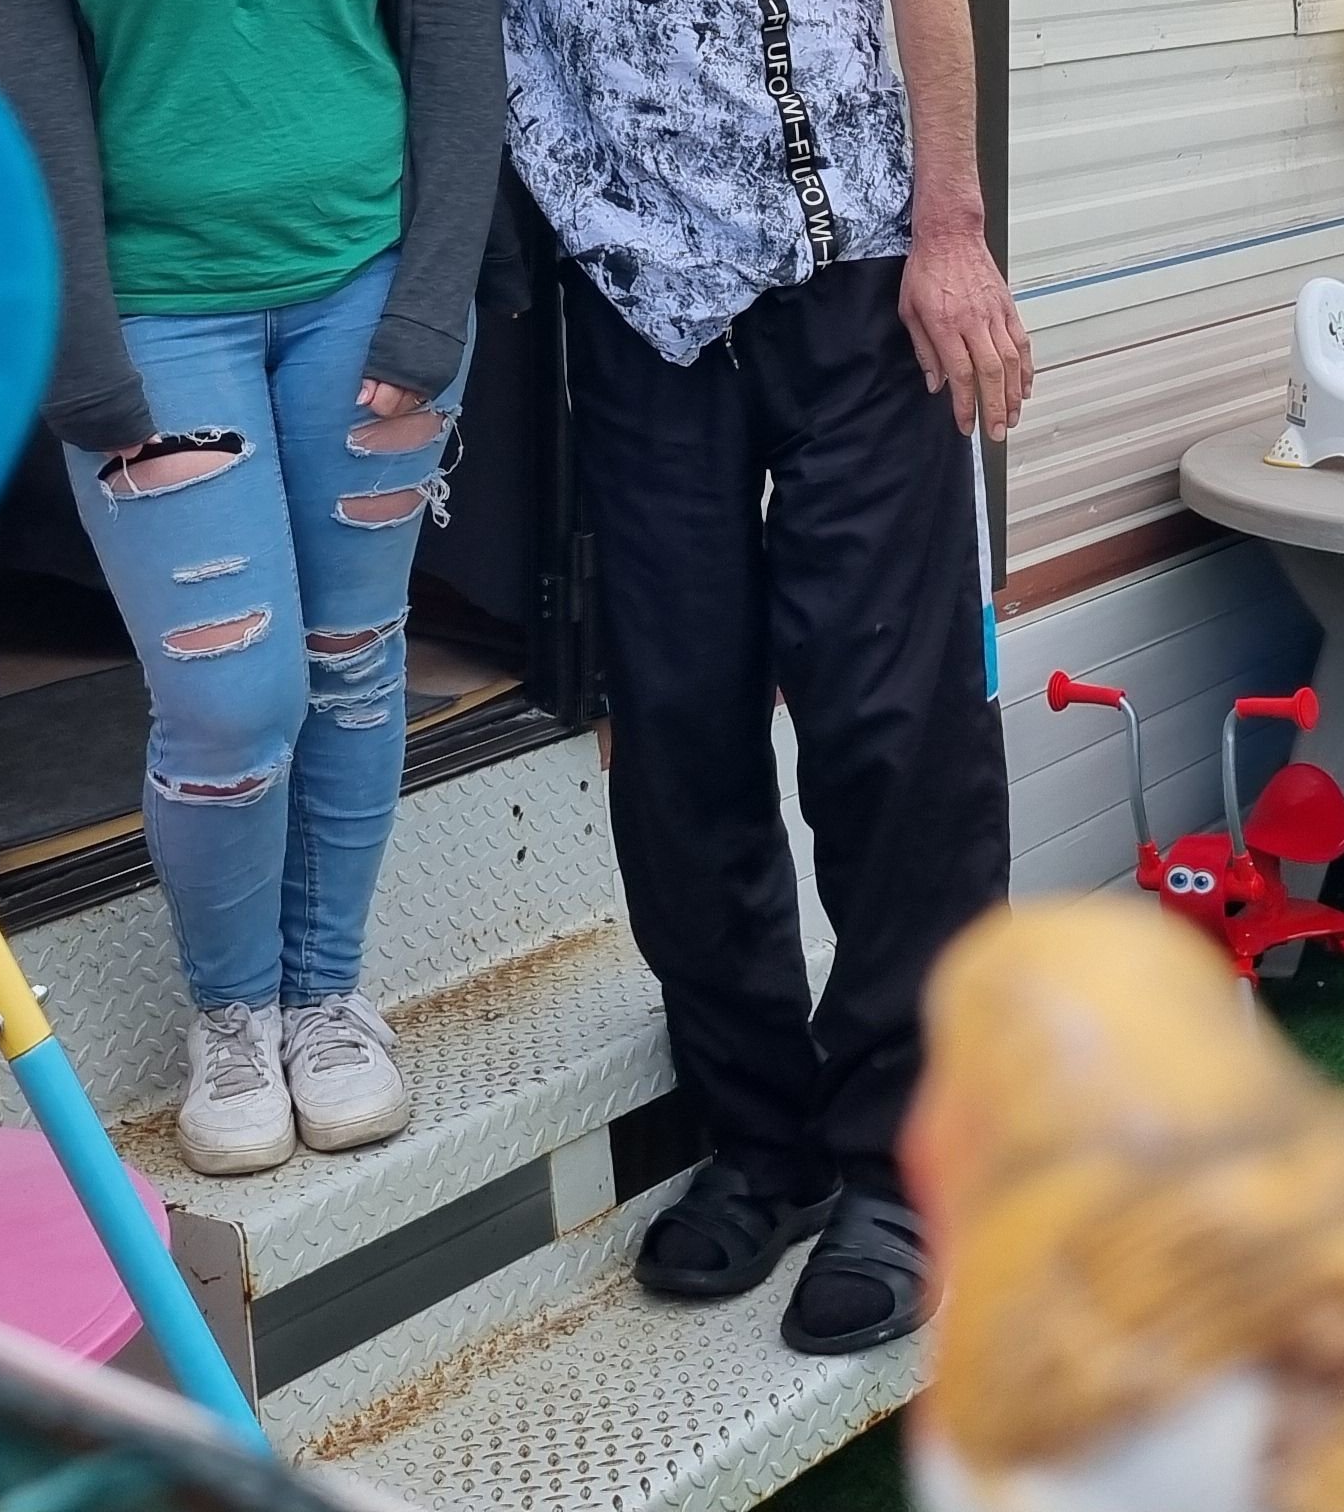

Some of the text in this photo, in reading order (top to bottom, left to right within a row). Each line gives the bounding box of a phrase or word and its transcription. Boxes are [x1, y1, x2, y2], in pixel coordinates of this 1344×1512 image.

[767, 41, 788, 96] UFO
[778, 92, 811, 163] WI-FI
[791, 166, 825, 206] UFO
